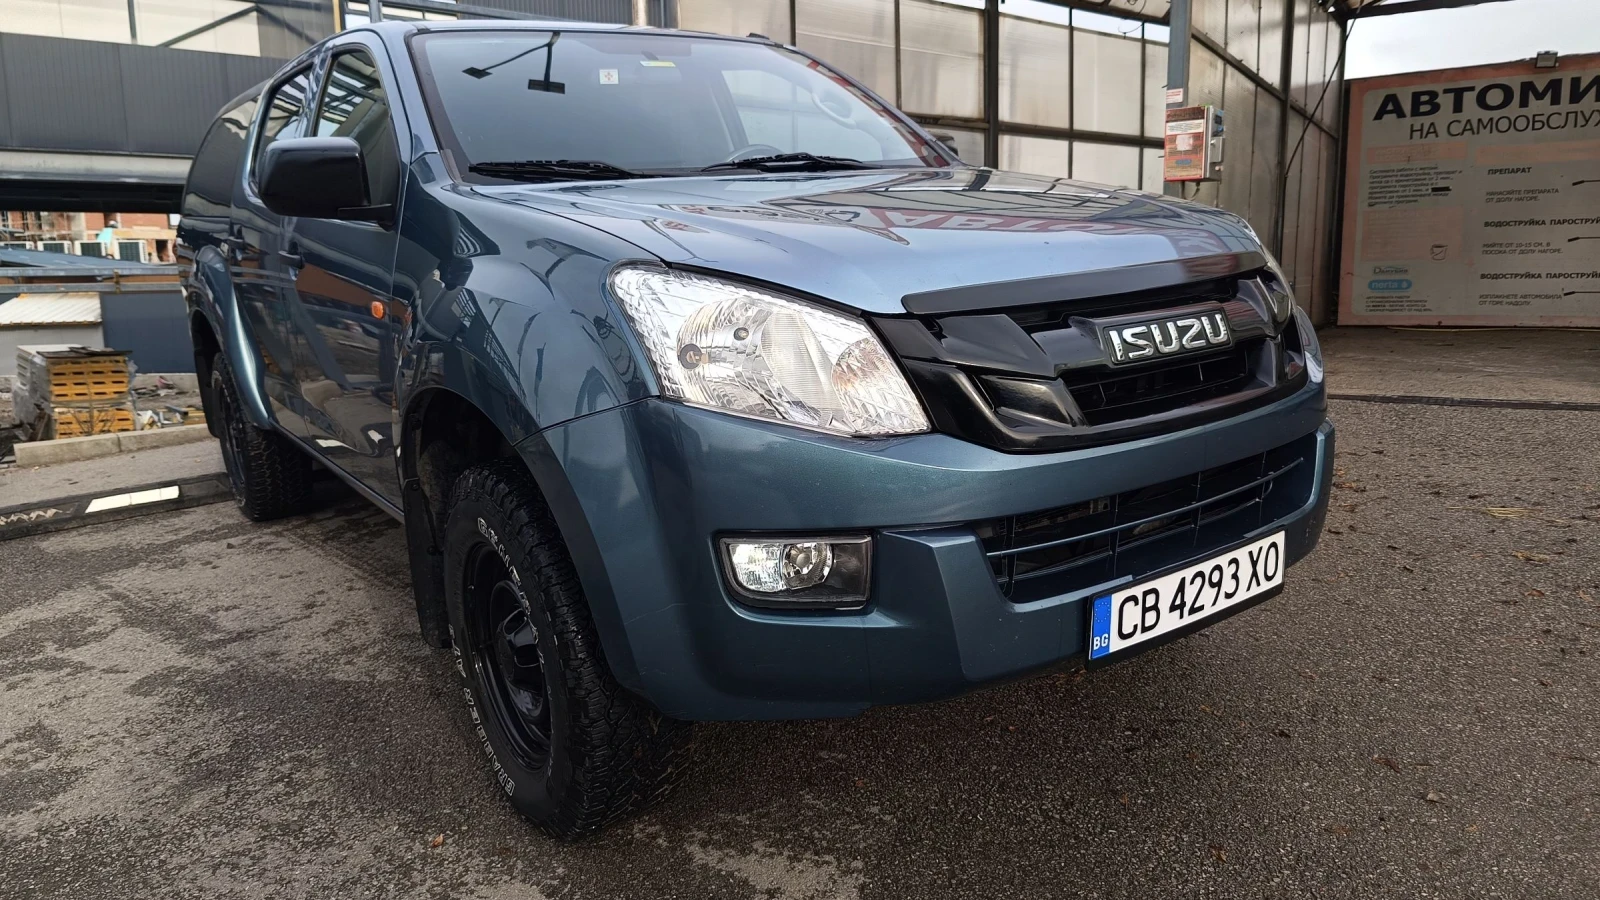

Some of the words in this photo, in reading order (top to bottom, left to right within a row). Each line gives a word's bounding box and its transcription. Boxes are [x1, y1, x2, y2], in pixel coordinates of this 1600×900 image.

[1373, 75, 1600, 121] АВТОМИ
[1409, 122, 1439, 140] НА
[1487, 166, 1532, 175] ПРЕПАРАТ
[1523, 187, 1560, 195] ПРЕПАРАТА
[1484, 218, 1546, 228] ВОДОСТРУЙКА
[1480, 271, 1542, 280] ВОДОСТРУЙКА
[1546, 271, 1600, 279] ПАРОСТРУЙ
[1371, 280, 1398, 289] nerta
[1109, 313, 1228, 361] ISUZU
[1117, 587, 1161, 641] CB
[1168, 557, 1240, 620] 4293
[1245, 541, 1280, 593] XO
[1093, 633, 1109, 651] BG
